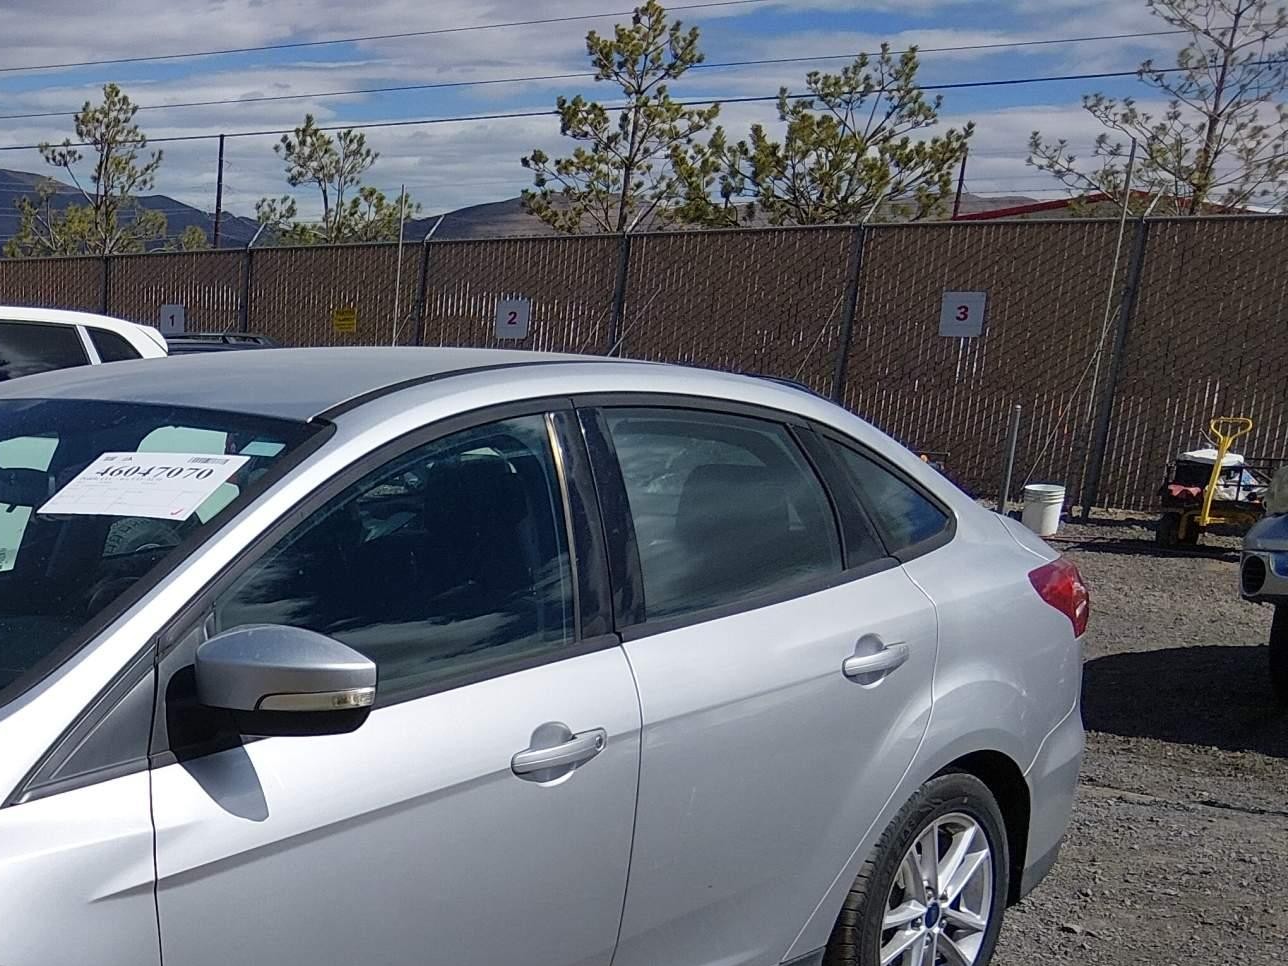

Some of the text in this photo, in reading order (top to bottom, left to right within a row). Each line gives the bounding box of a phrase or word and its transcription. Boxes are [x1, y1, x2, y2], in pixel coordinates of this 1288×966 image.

[169, 314, 175, 327] 1
[507, 311, 517, 325] 2
[955, 305, 969, 321] 3
[96, 465, 214, 481] 46047070
